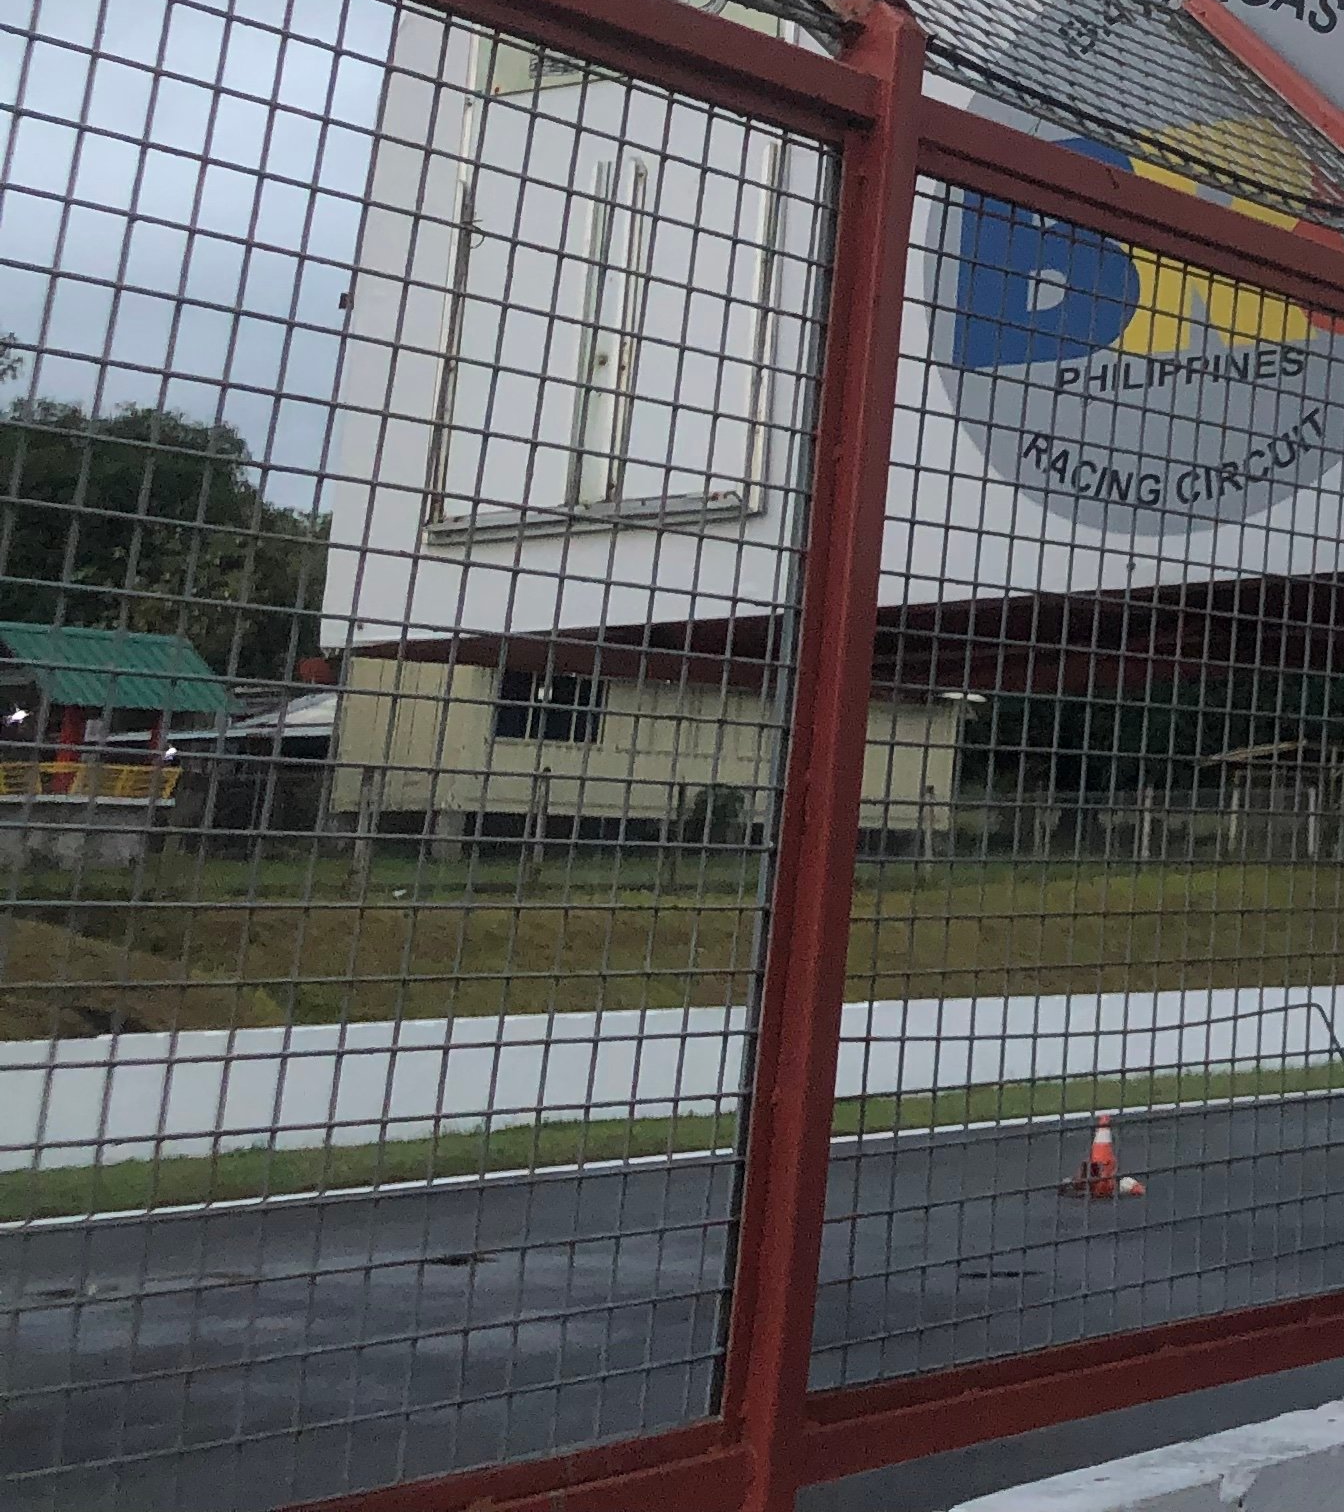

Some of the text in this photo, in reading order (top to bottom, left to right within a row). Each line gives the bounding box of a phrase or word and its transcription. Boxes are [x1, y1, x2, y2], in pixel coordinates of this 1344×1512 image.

[1056, 346, 1306, 391] PHILIPPINES
[1022, 406, 1326, 507] RACING CIRCUIT
